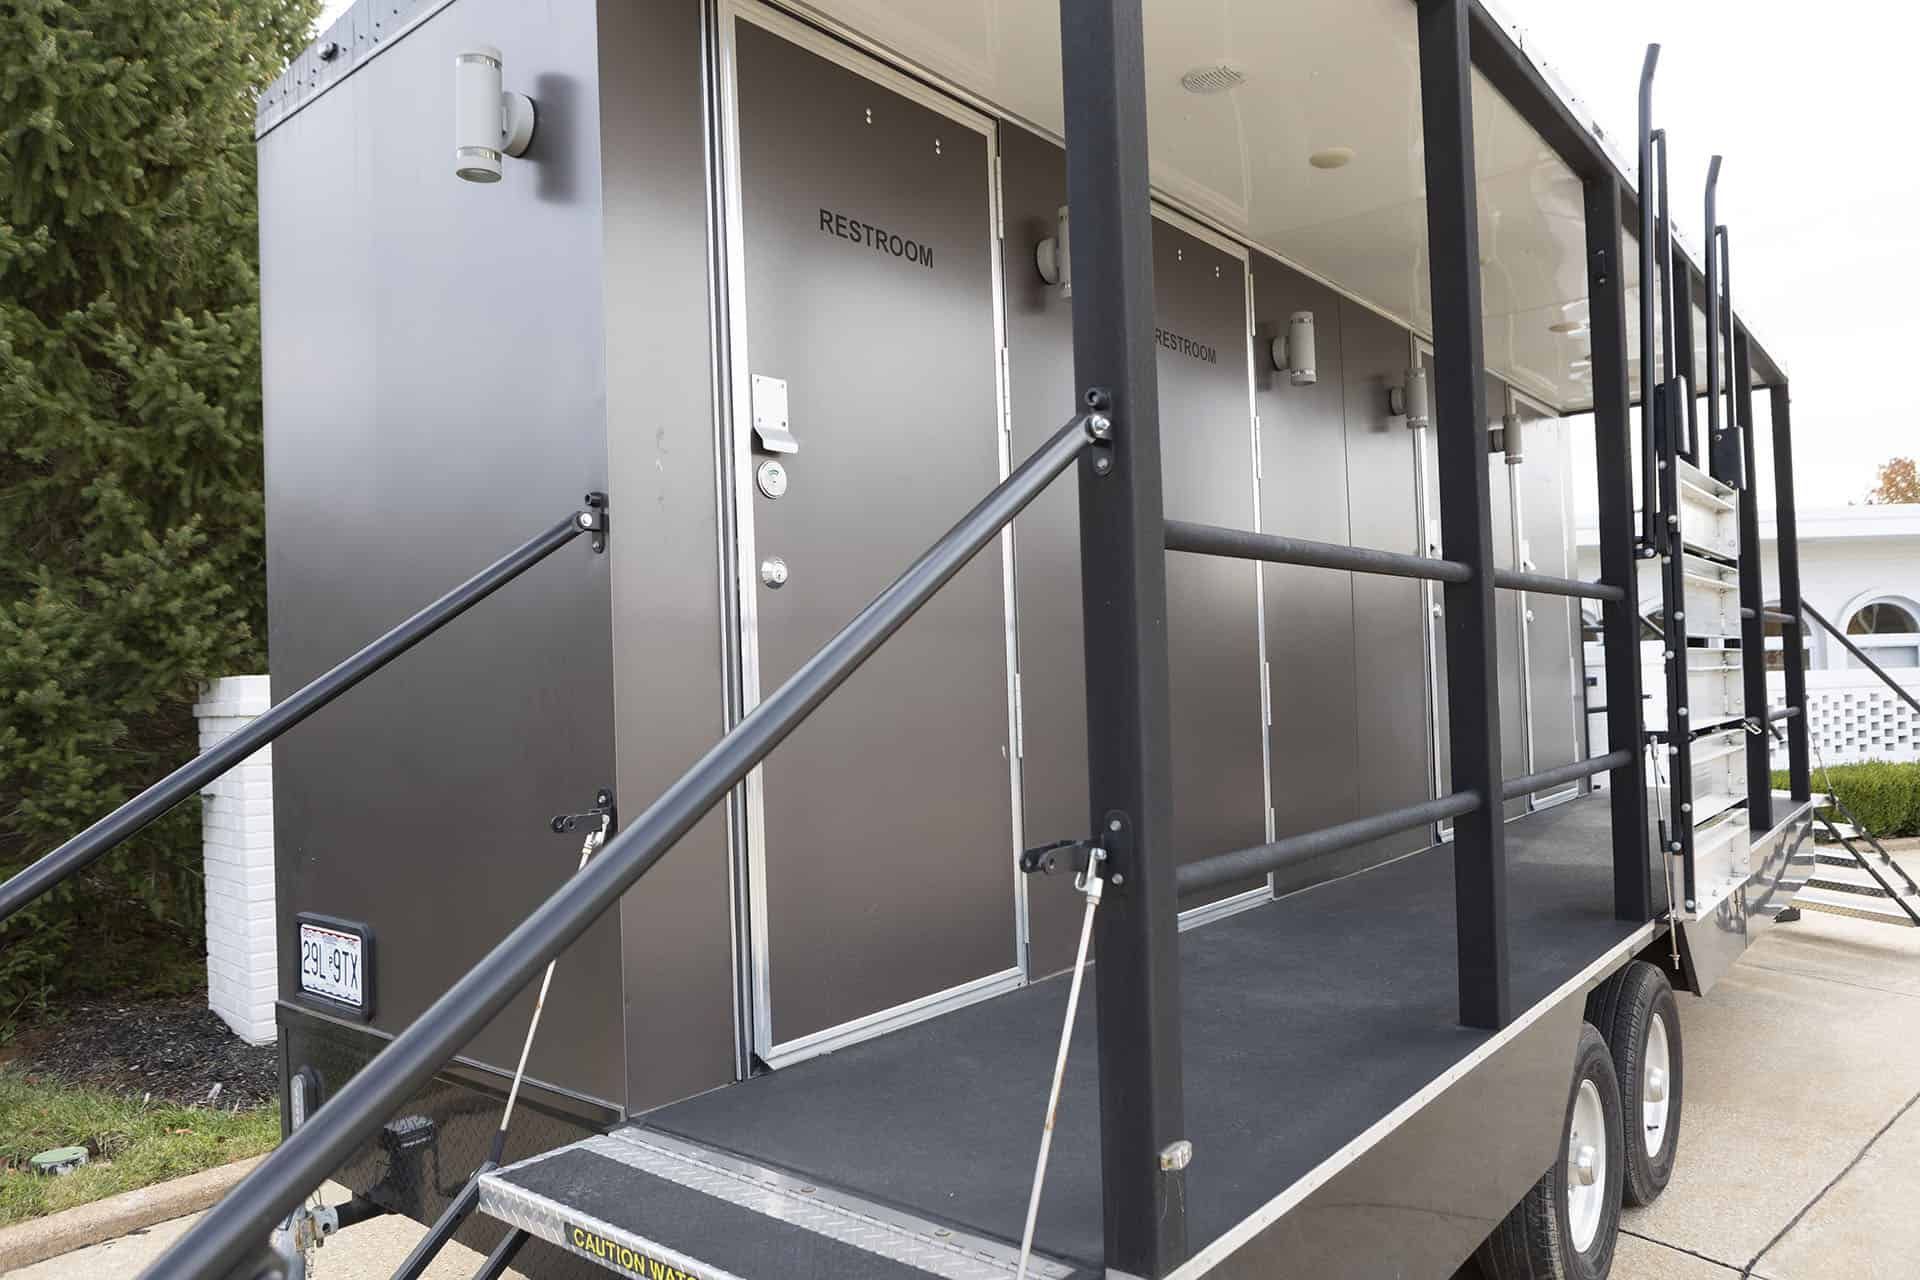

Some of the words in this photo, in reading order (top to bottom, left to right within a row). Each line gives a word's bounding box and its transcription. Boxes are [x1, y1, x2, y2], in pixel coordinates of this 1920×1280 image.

[819, 208, 934, 269] RESTROOM
[1155, 328, 1217, 365] RESTROOM
[303, 940, 326, 980] 29L
[333, 948, 358, 990] 9TX
[573, 1228, 645, 1275] CAUTION
